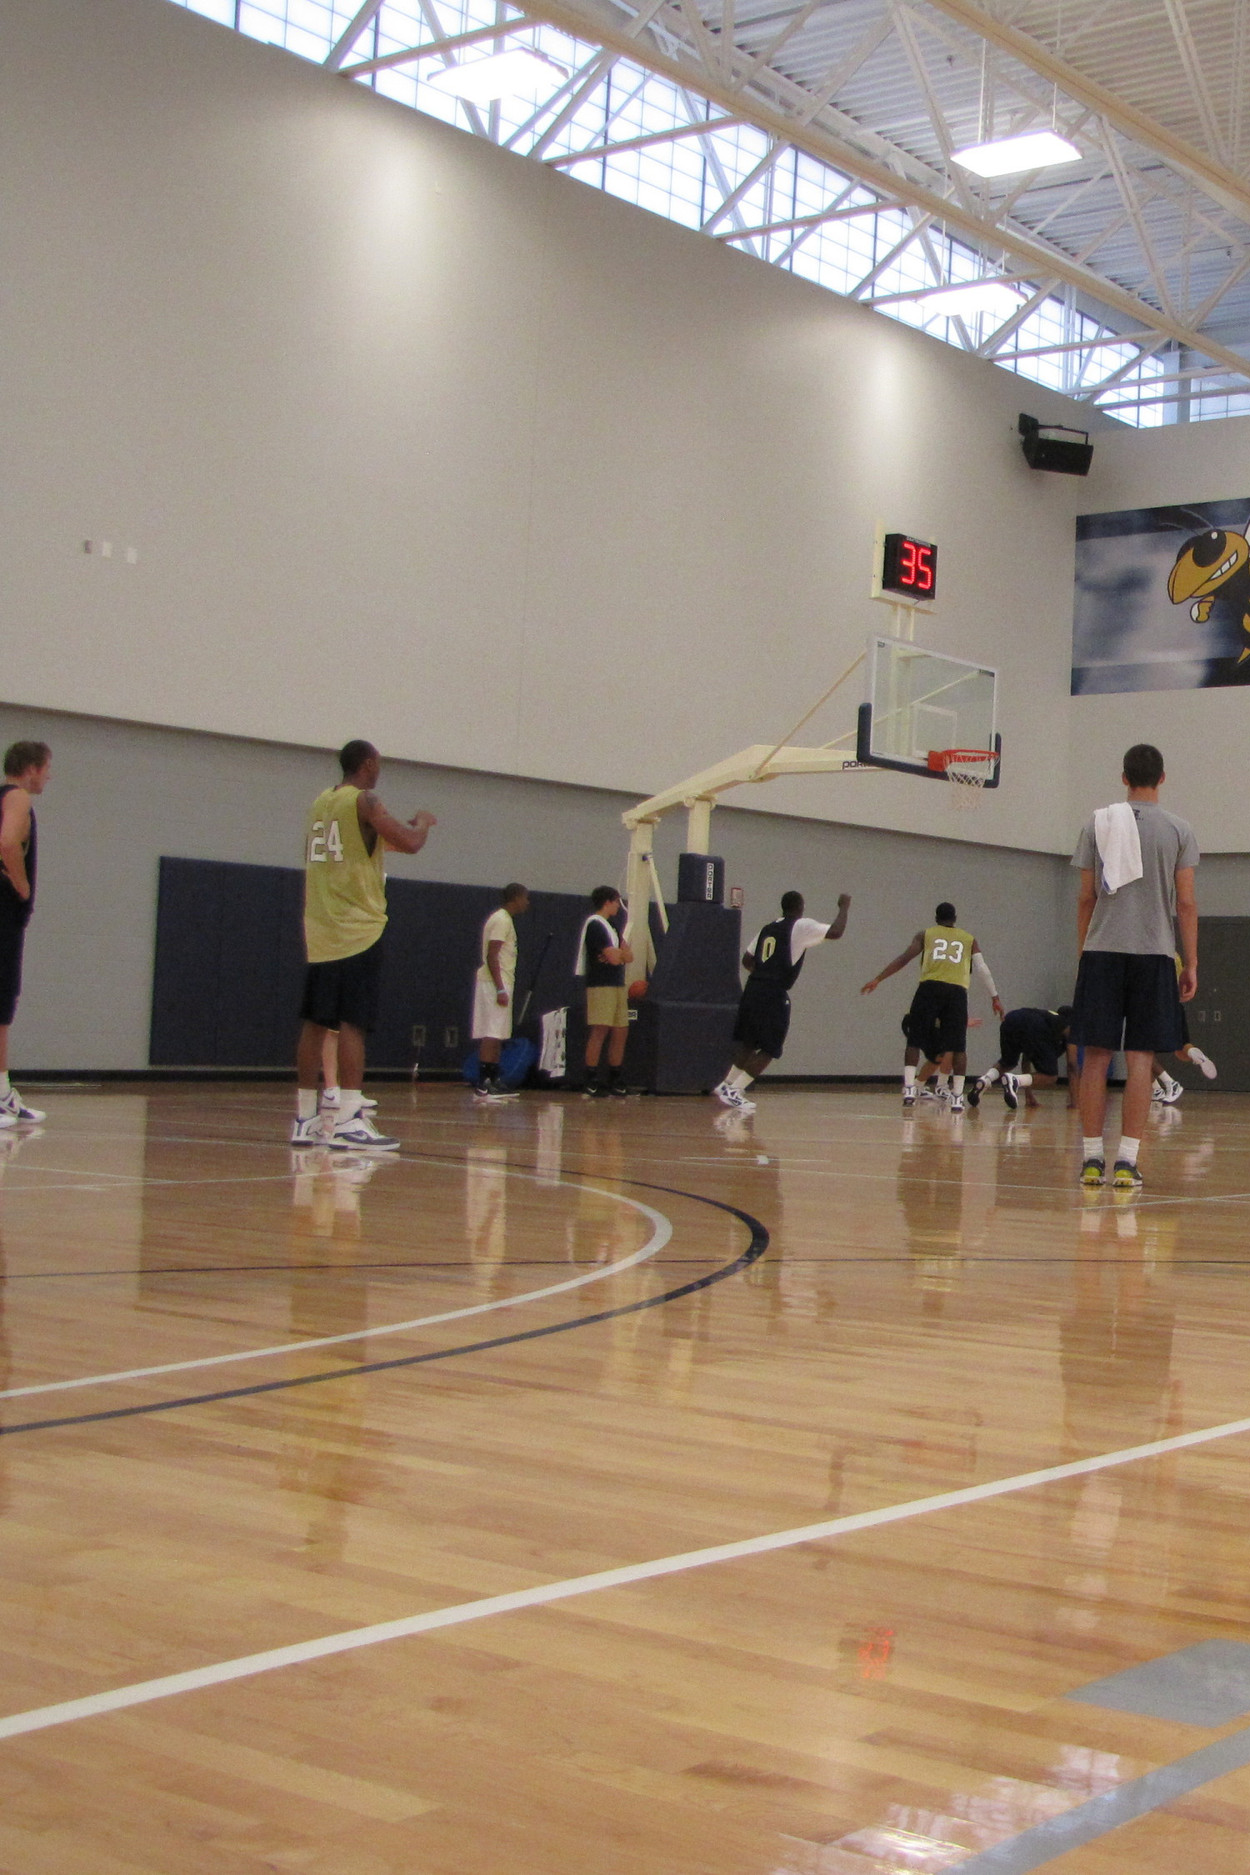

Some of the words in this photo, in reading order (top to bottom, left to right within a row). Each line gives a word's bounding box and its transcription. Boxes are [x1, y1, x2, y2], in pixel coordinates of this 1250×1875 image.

[901, 541, 932, 590] 35
[310, 820, 344, 862] 24
[761, 936, 776, 963] 0
[932, 938, 964, 964] 23
